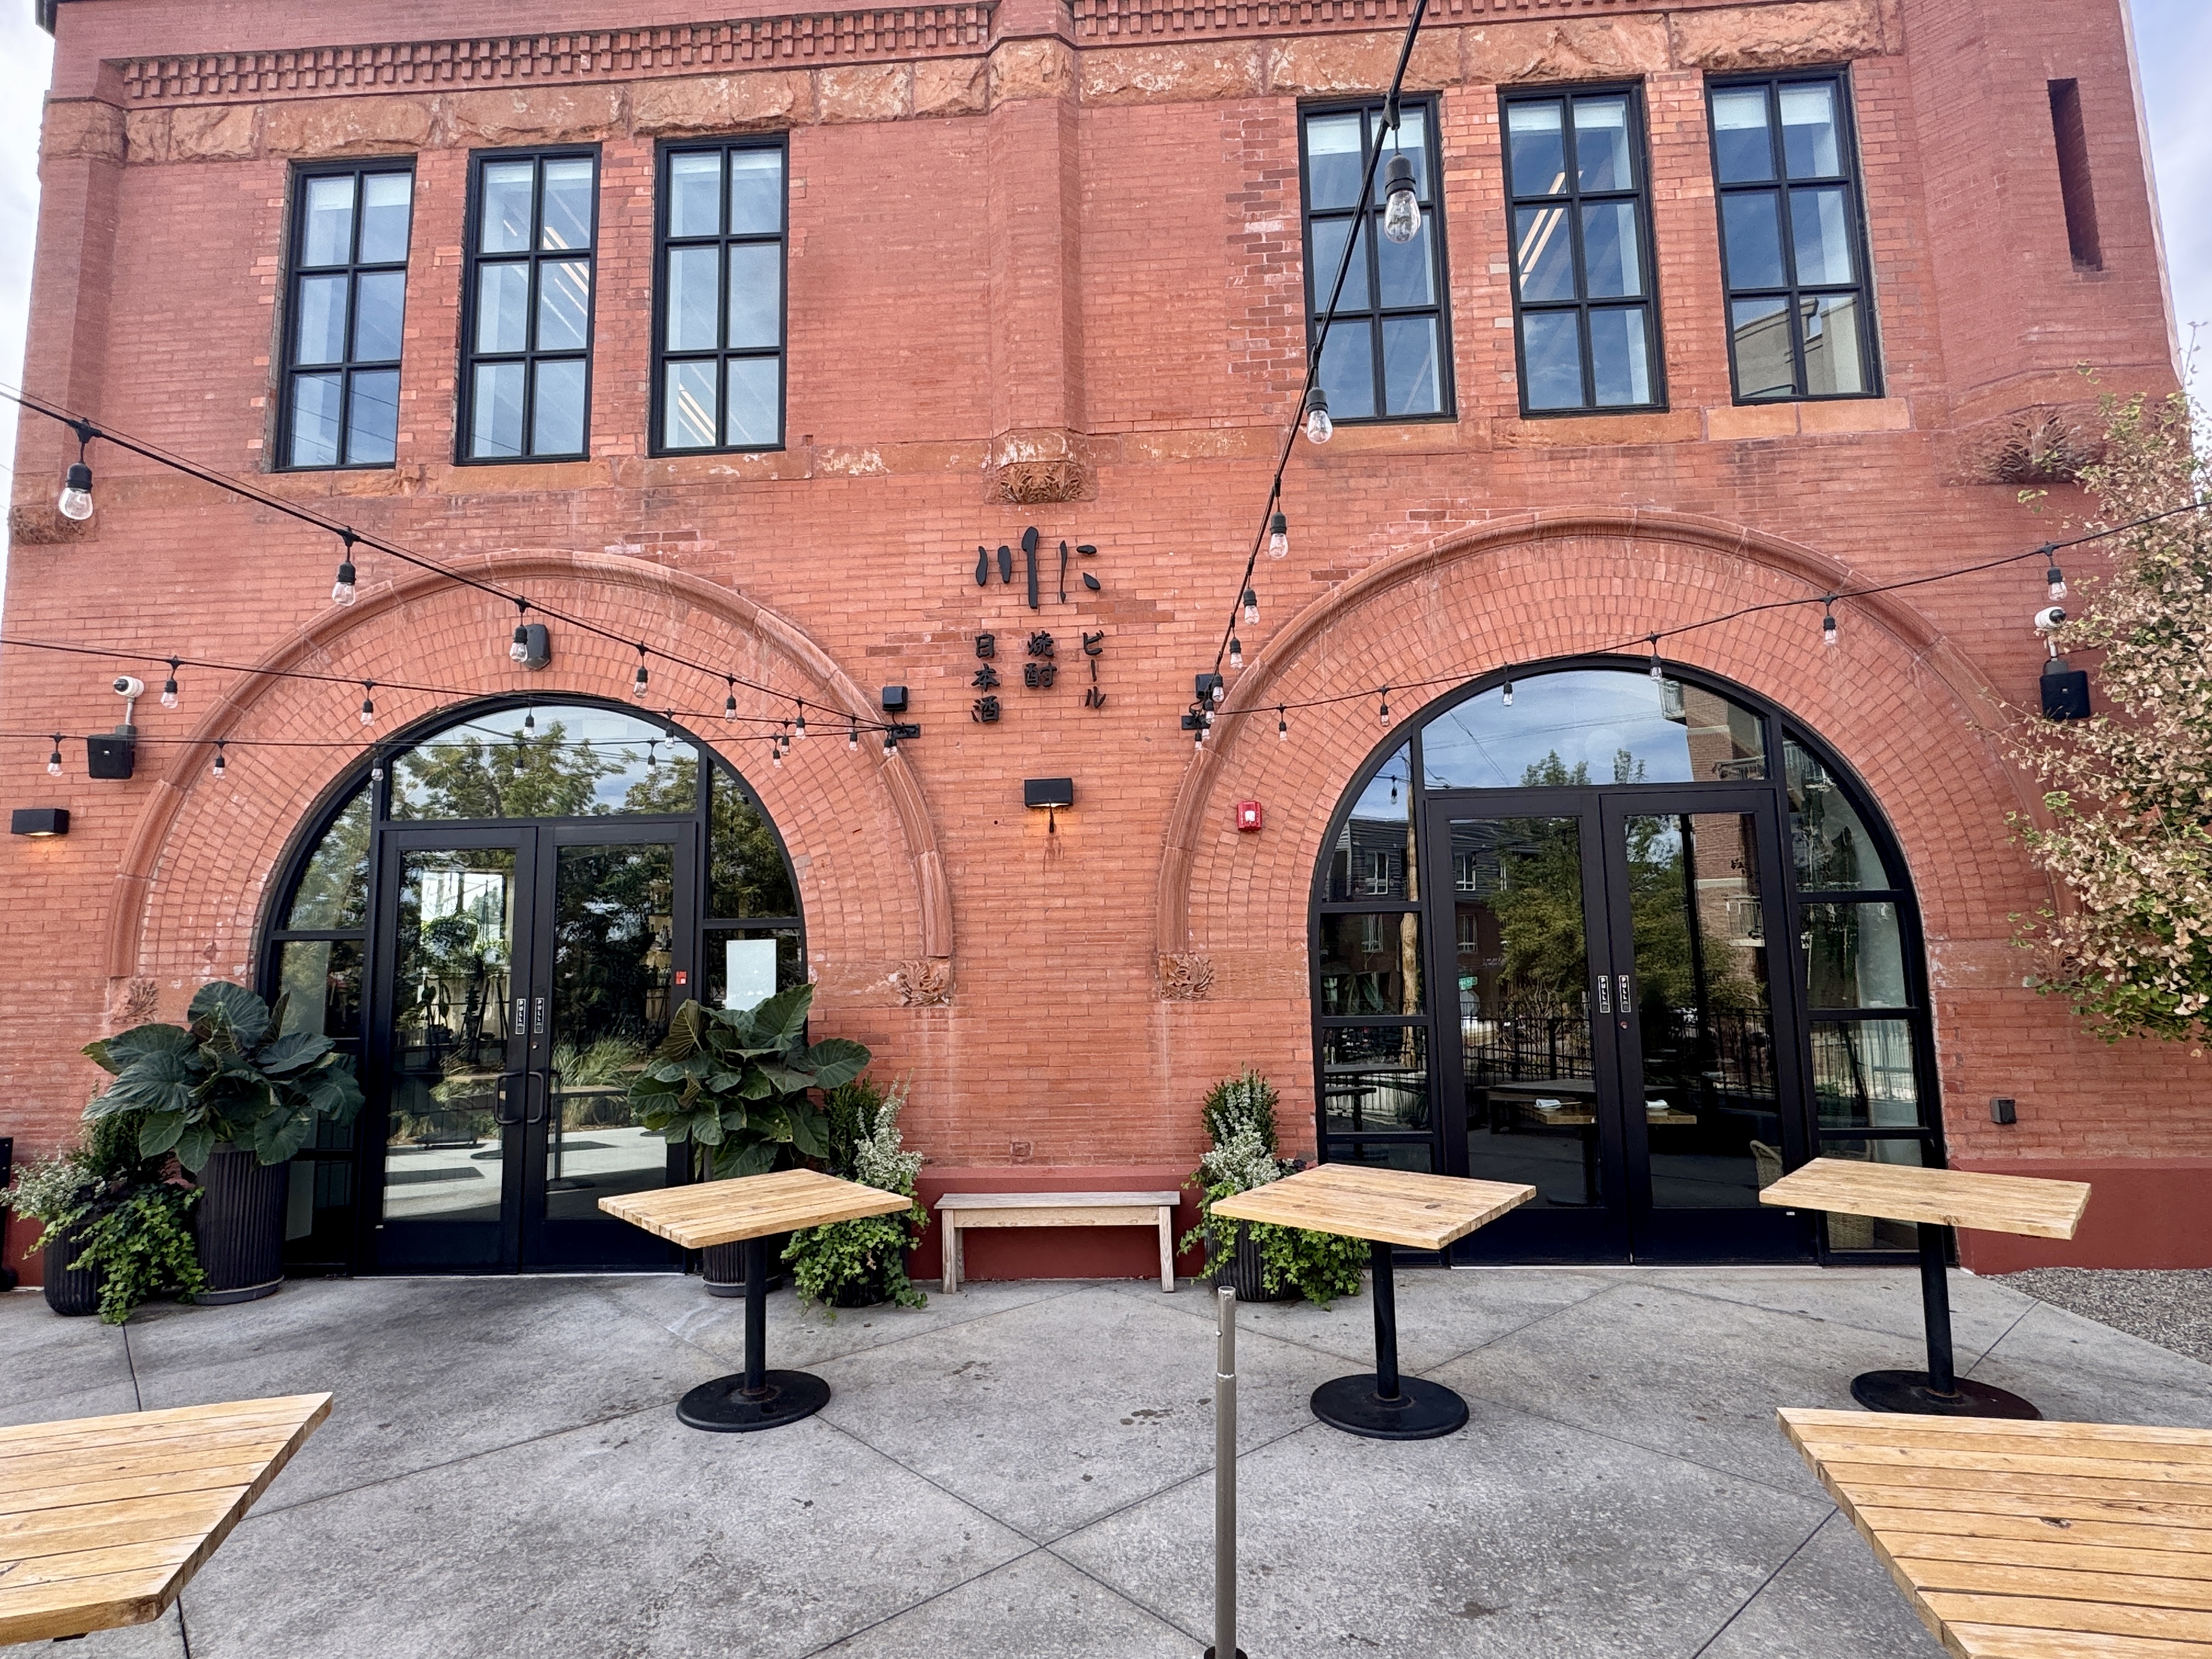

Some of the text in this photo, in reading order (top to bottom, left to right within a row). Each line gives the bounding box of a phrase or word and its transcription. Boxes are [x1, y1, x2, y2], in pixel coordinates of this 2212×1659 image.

[970, 633, 1001, 723] 日本酒
[1025, 630, 1057, 688] 焼酎
[1082, 630, 1106, 709] ビール
